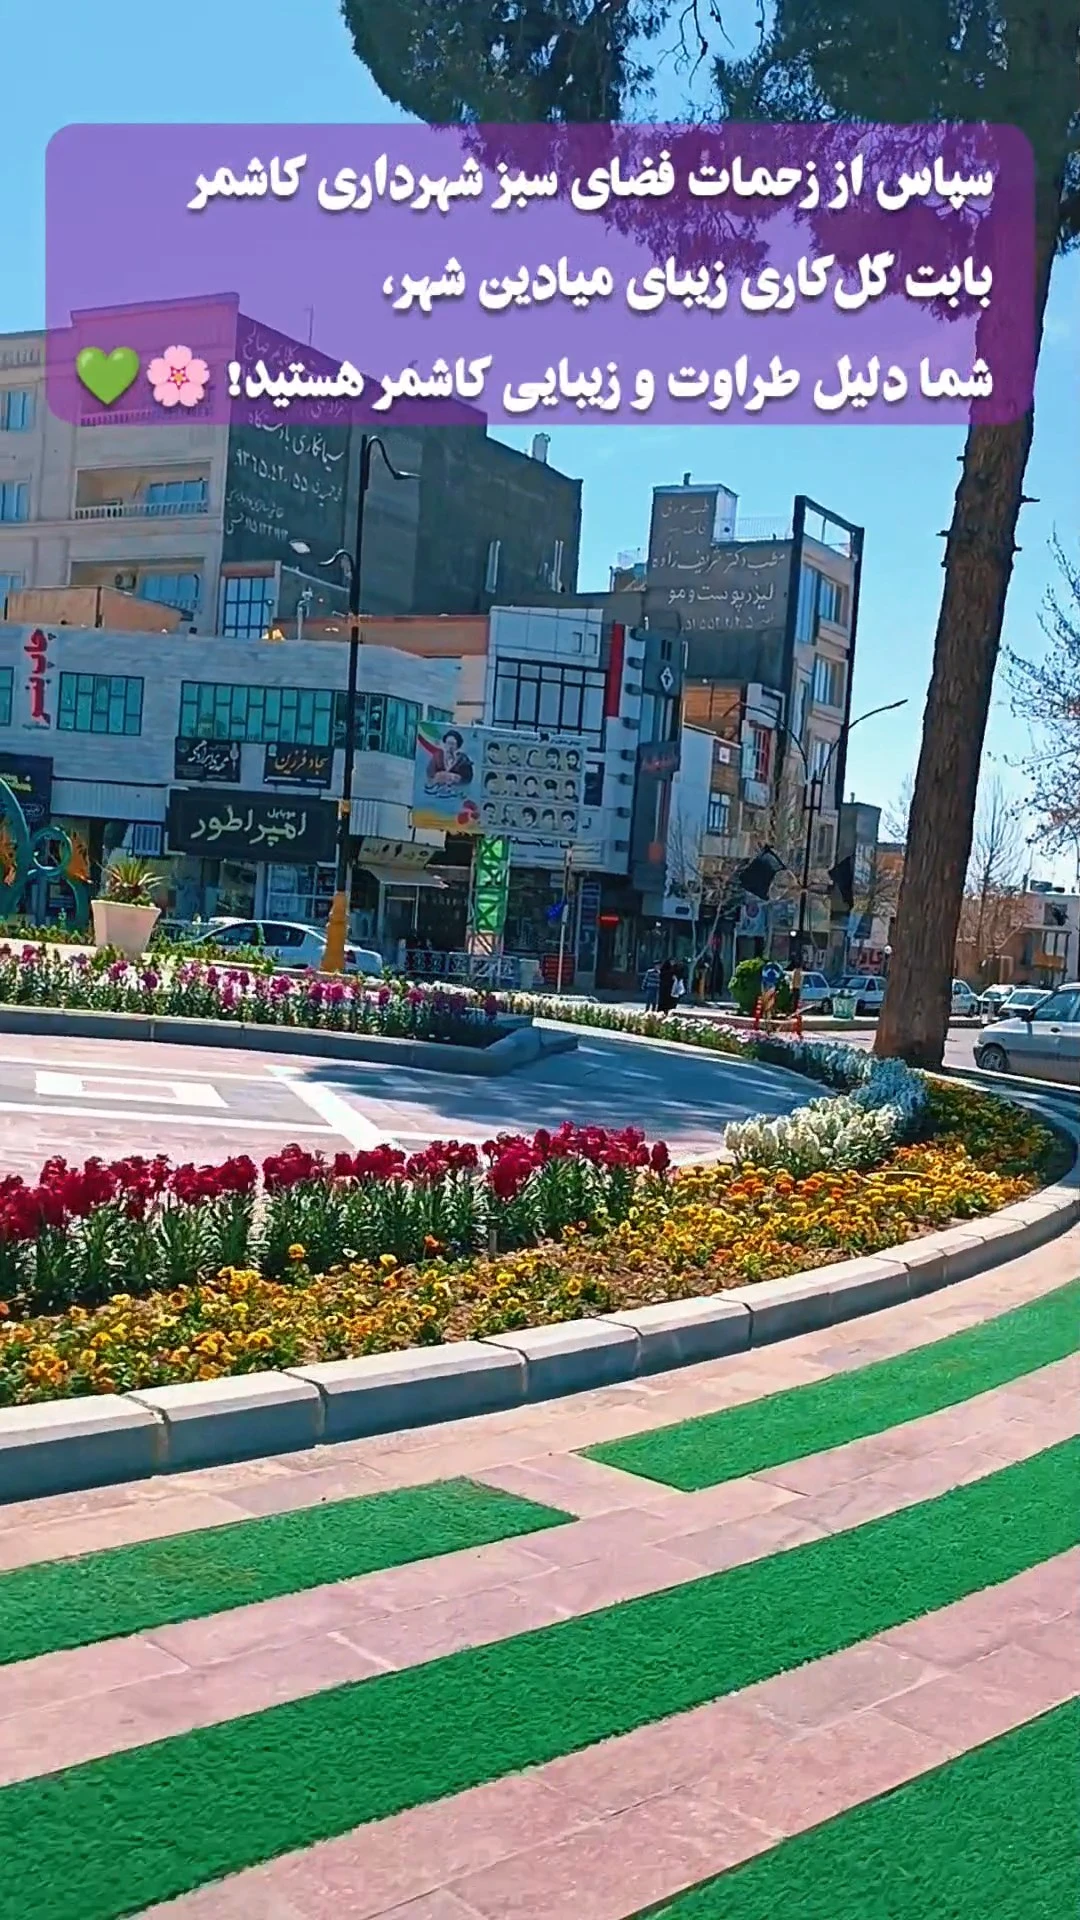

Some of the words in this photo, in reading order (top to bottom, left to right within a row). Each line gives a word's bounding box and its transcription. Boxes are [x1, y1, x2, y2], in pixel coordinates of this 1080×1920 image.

[667, 589, 686, 605] مو
[687, 589, 695, 603] و
[697, 586, 745, 612] پوست
[745, 583, 774, 610] لیزر
[190, 805, 307, 847] امپراطور
